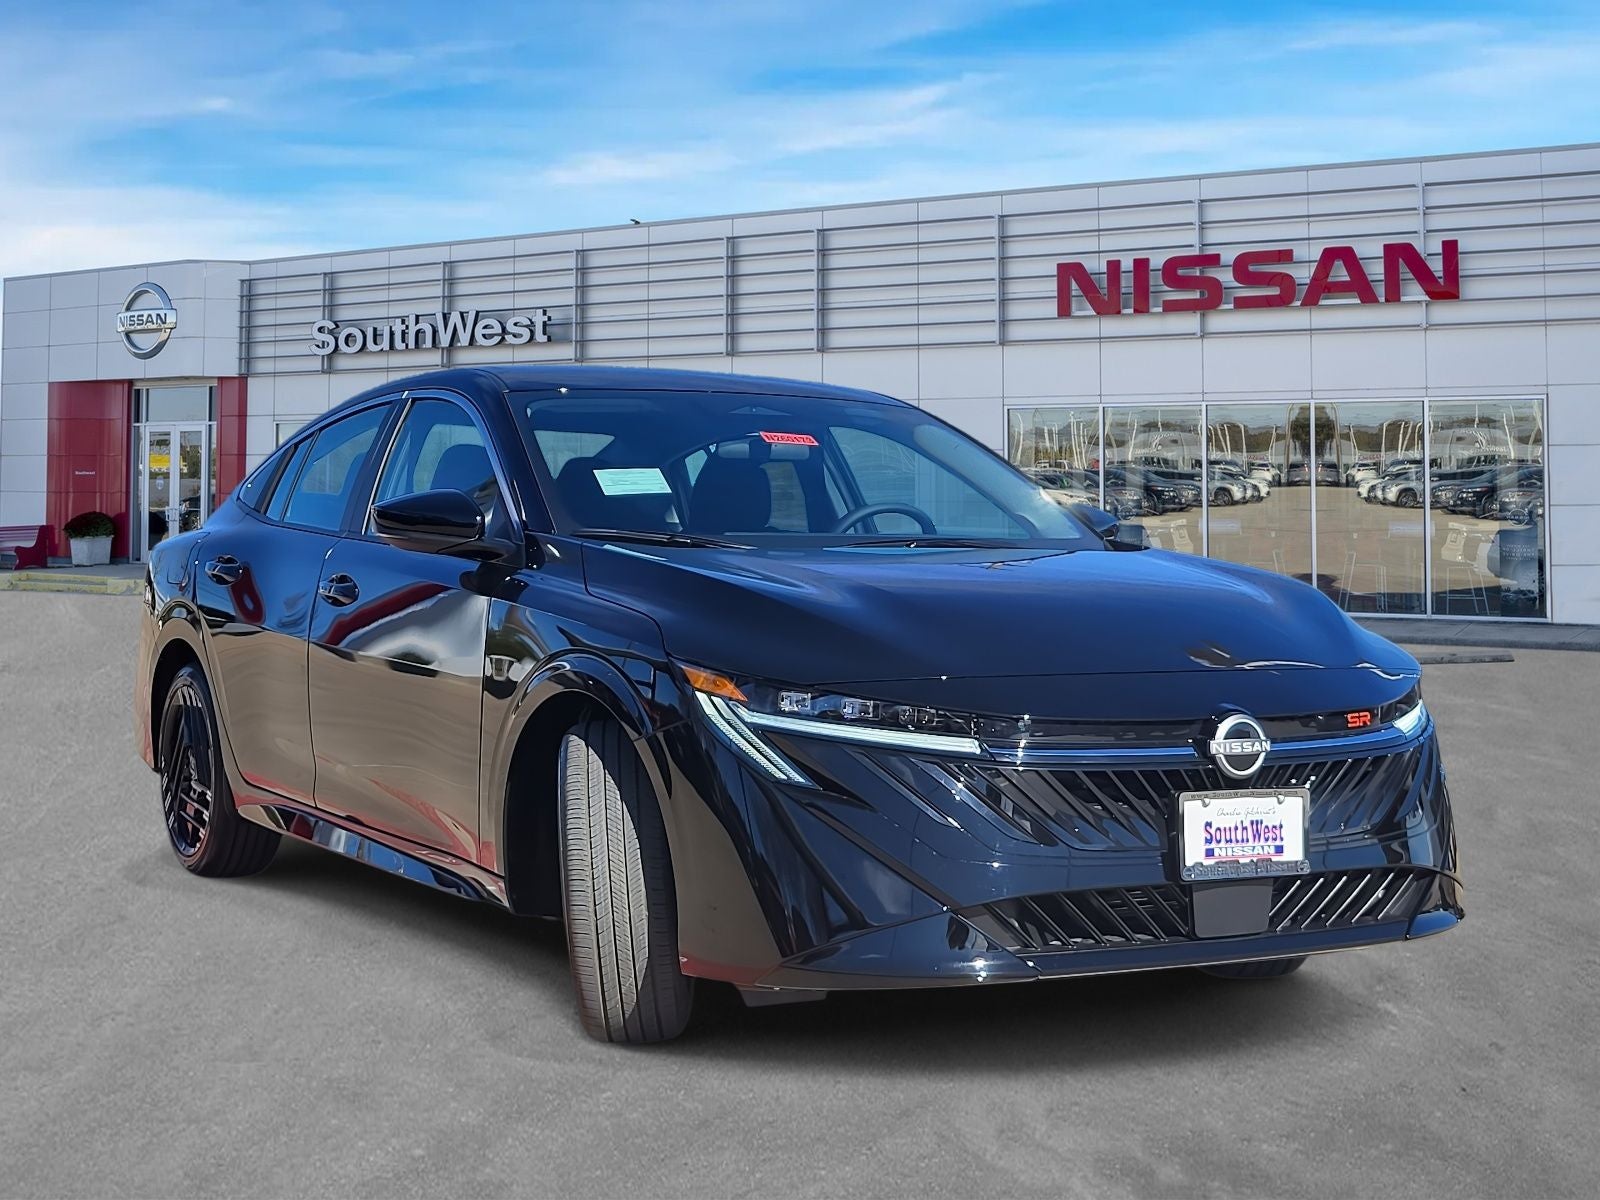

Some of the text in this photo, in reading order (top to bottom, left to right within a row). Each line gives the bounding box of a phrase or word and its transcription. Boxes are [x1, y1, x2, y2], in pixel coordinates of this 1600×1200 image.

[1056, 239, 1460, 317] NISSAN
[118, 312, 167, 328] NISSAN
[308, 308, 552, 356] SouthWest
[1347, 711, 1371, 728] SR
[1211, 740, 1271, 754] NISSAN
[1204, 819, 1284, 845] SouthWest
[1213, 845, 1275, 857] NISSAN
